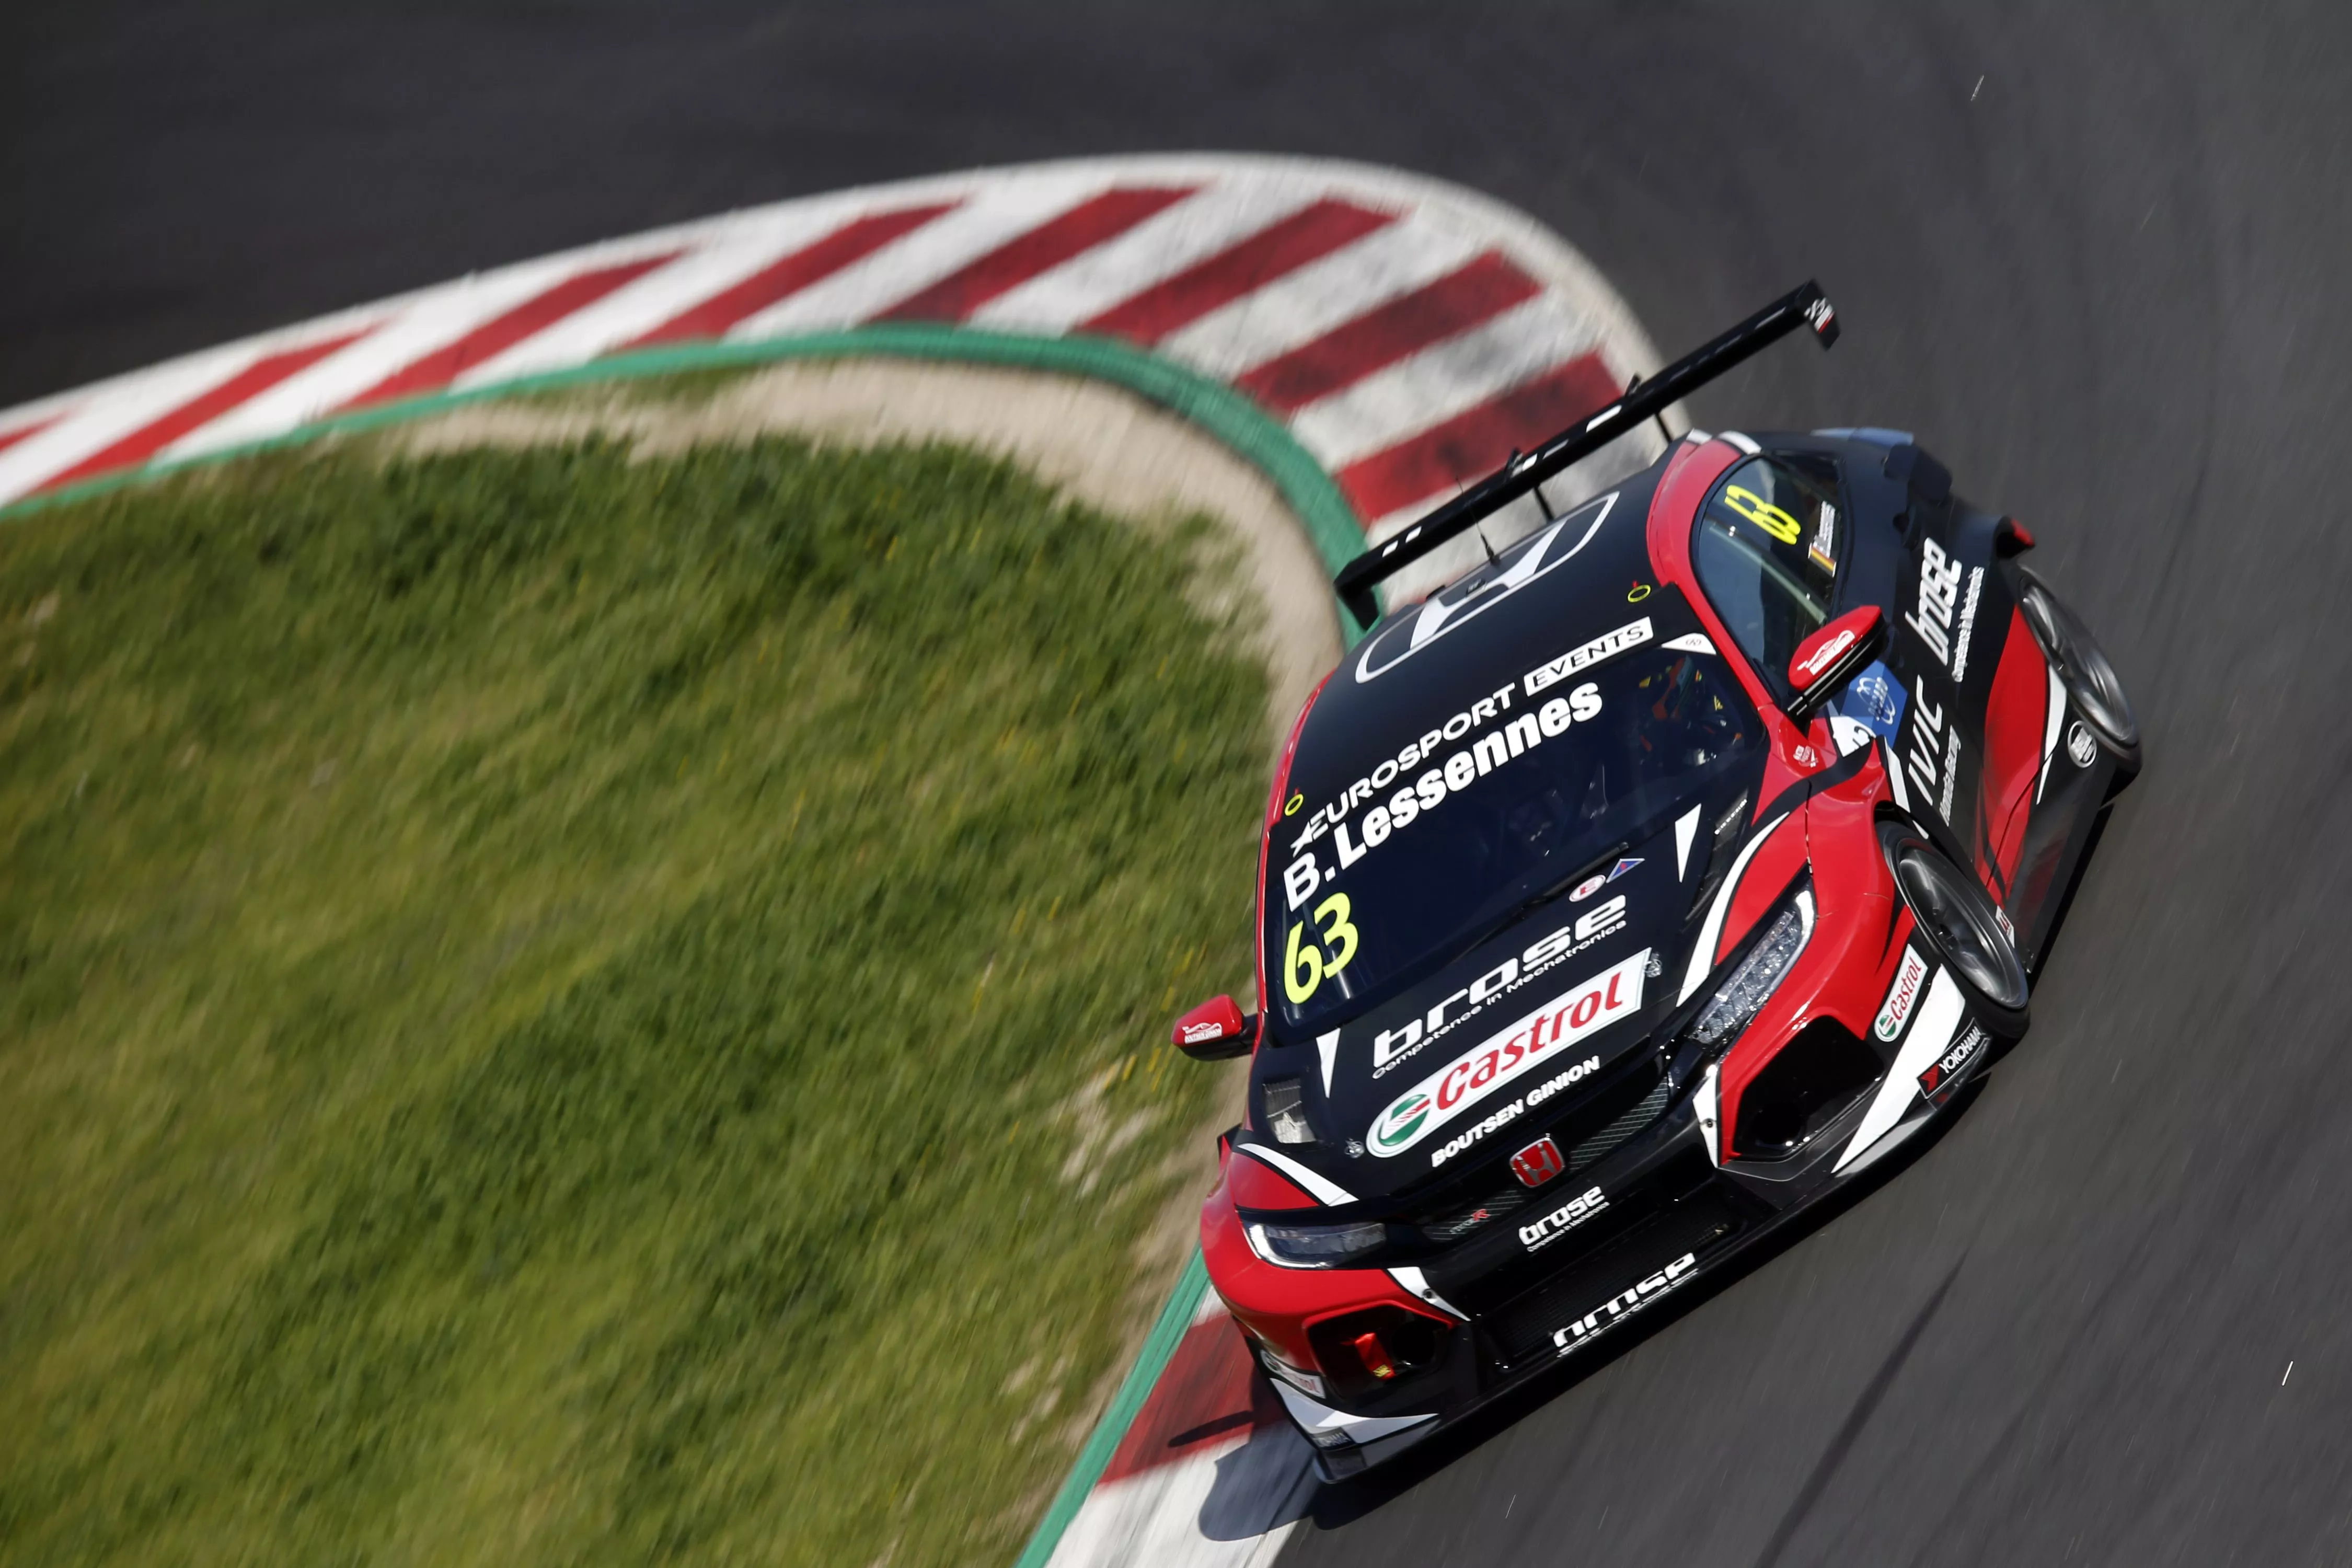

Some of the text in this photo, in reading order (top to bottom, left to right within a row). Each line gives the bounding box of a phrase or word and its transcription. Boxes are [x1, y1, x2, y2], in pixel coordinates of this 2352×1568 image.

[1905, 537, 1962, 666] brose
[1310, 625, 1644, 840] EUROSPORT EVENTS
[1908, 674, 1942, 806] IVIC
[1284, 892, 1358, 1004] 63
[1374, 894, 1625, 1068] brose
[1486, 991, 1503, 1006] in
[1506, 920, 1627, 993] Mechatronics
[1890, 956, 1921, 1020] Castrol
[1436, 971, 1623, 1111] Castrol
[1939, 1026, 1982, 1074] YOKOHAMA
[1432, 1056, 1600, 1168] BOUTSEN GINION
[1518, 1186, 1605, 1245] brose
